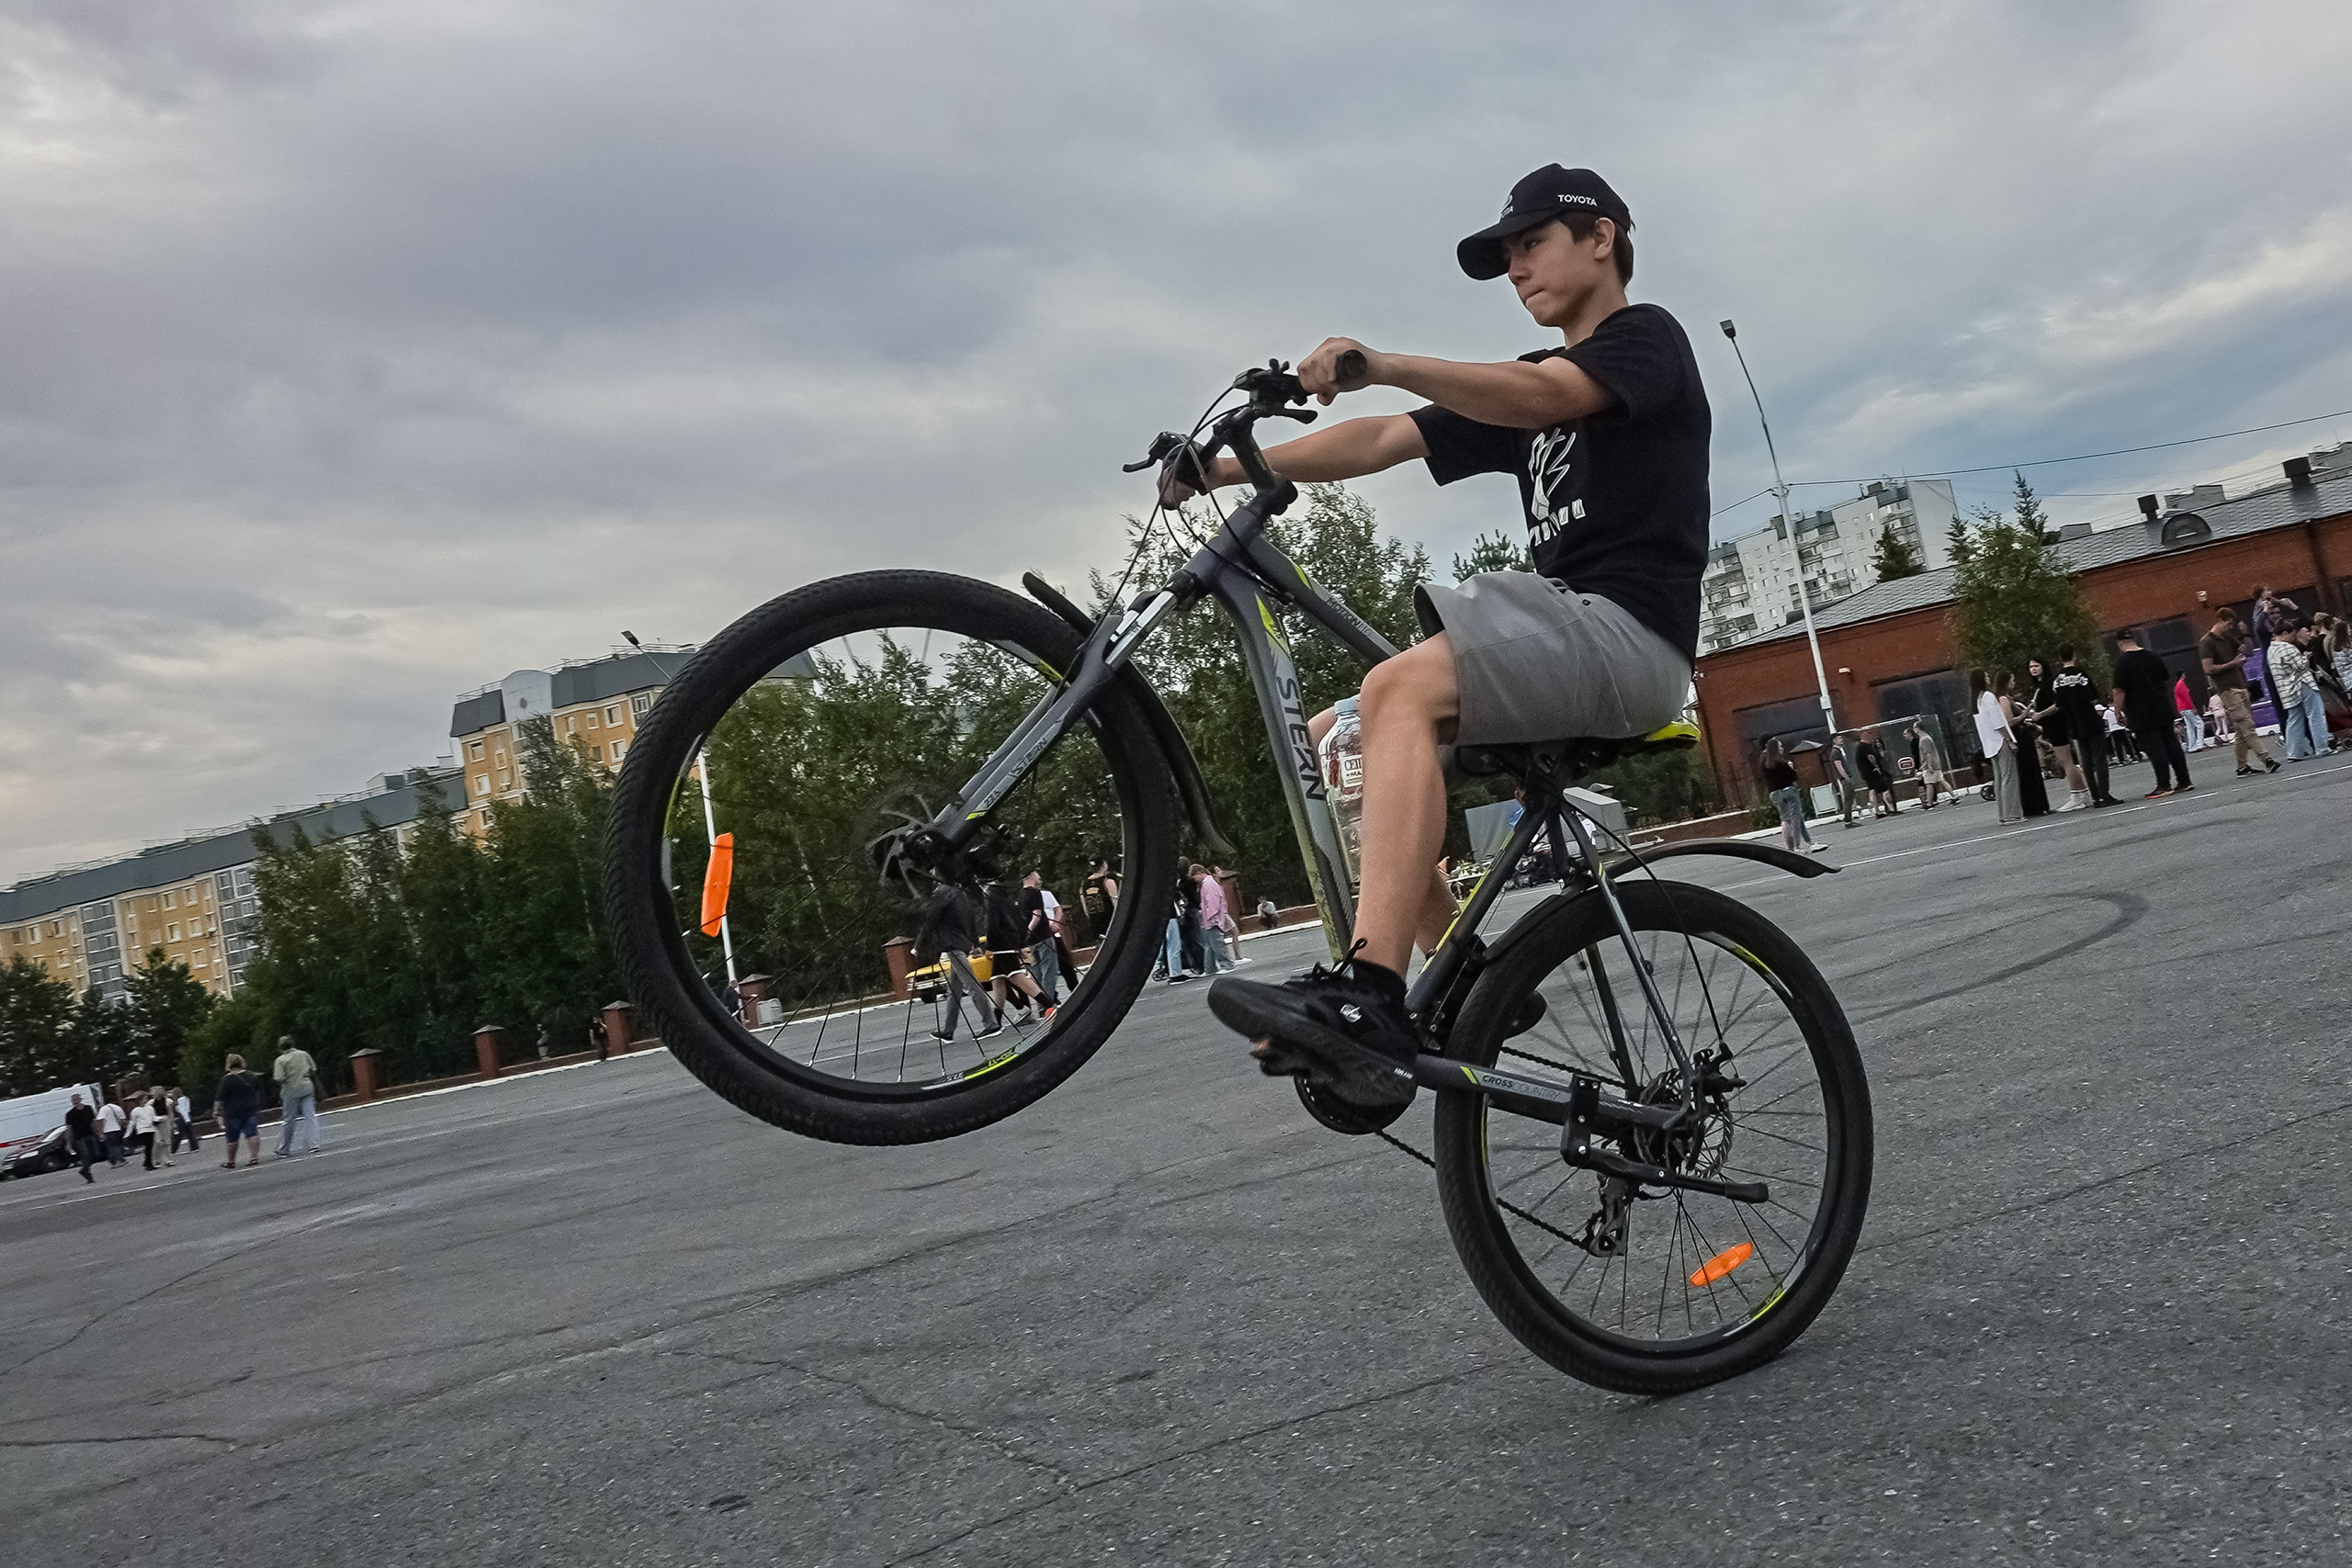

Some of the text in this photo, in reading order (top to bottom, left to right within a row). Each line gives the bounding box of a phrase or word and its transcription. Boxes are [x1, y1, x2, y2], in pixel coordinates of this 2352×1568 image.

[1557, 194, 1598, 208] TOYOTA
[1326, 596, 1362, 627] MOTION
[1276, 676, 1328, 801] STERN
[1012, 737, 1048, 775] STERN
